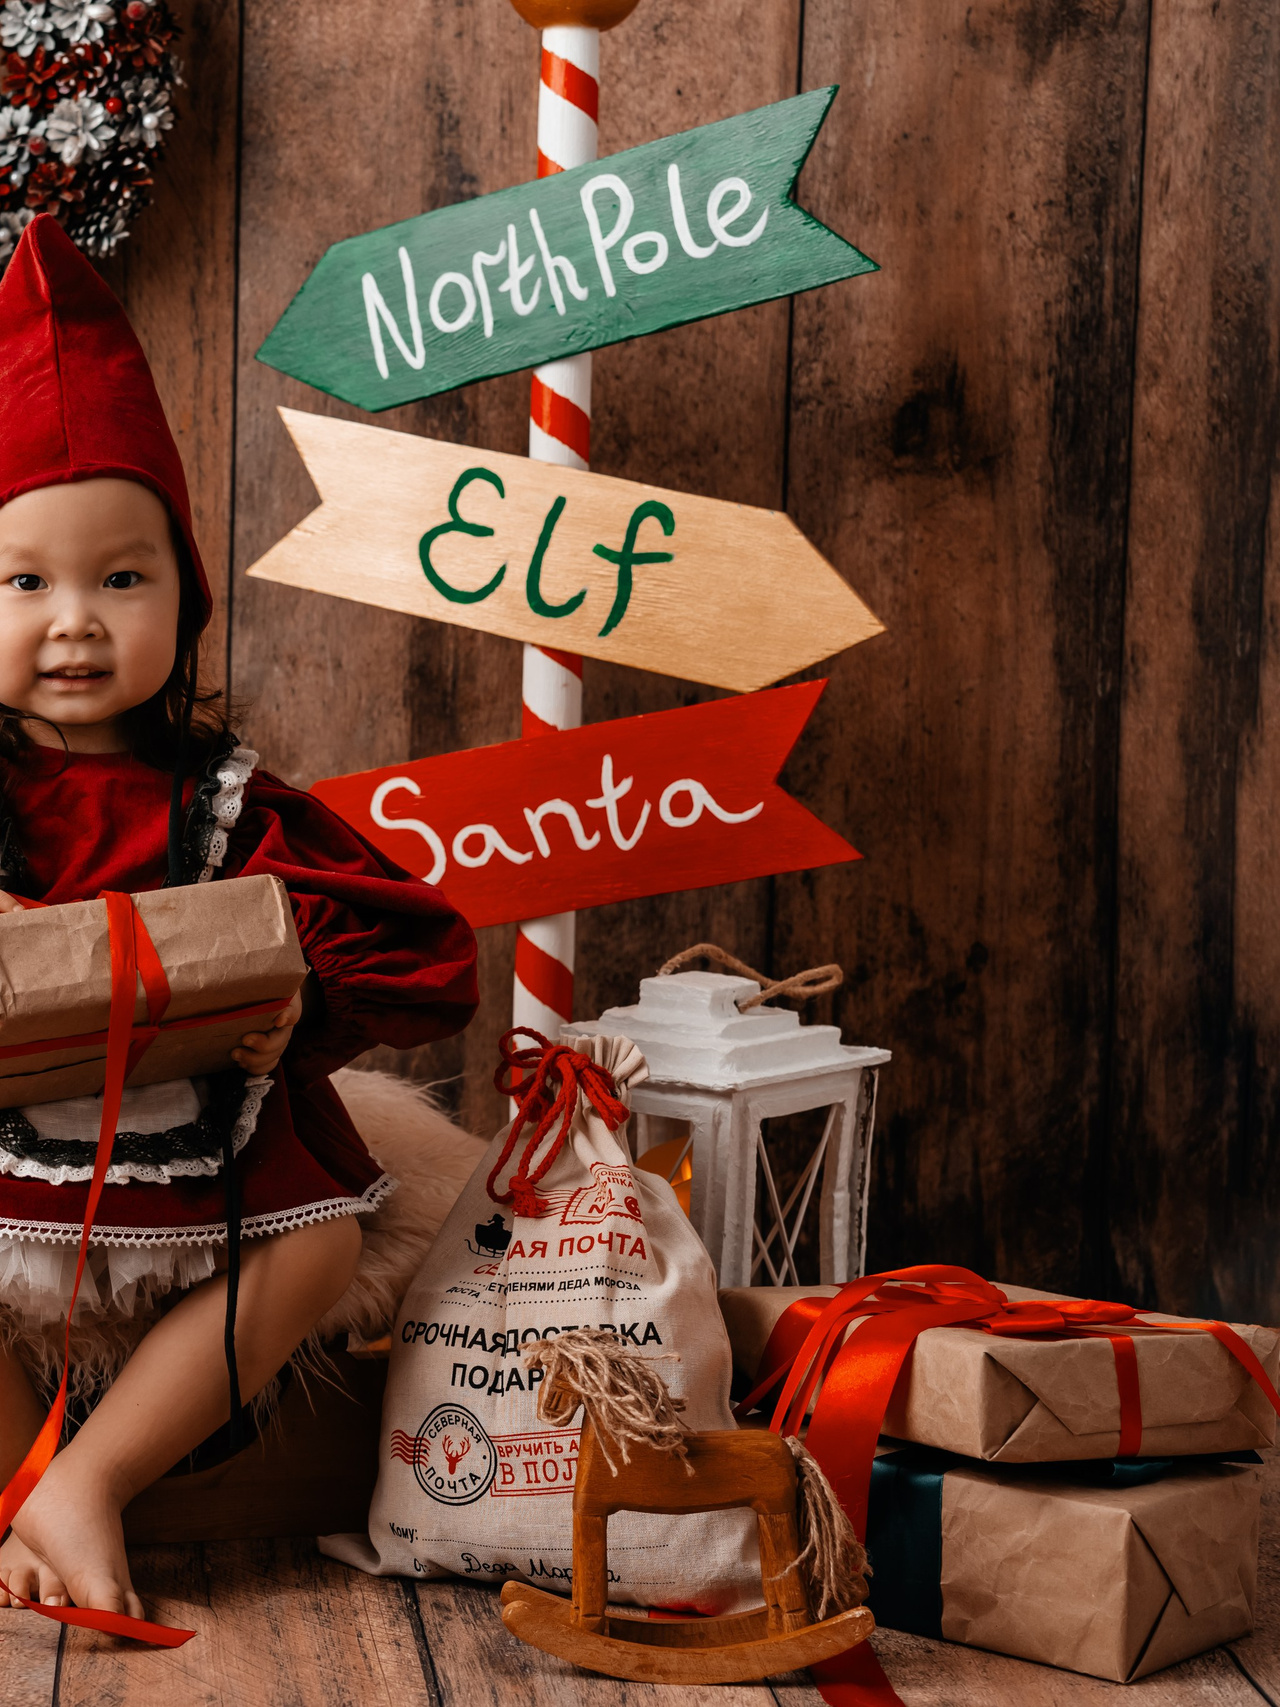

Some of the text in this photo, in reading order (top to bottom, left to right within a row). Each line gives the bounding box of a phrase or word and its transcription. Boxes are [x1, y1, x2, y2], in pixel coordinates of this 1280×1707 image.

[361, 163, 769, 380] North Pole
[418, 467, 676, 637] Elf
[370, 753, 764, 885] Santa
[558, 1231, 647, 1261] ПОЧТА
[558, 1278, 591, 1292] ДЕДА
[594, 1276, 642, 1292] МОРОЗА
[401, 1320, 663, 1359] СРОЧНАЯ ДОСТКА
[451, 1363, 545, 1398] ПОДАР
[428, 1414, 483, 1445] СЕВЕРНАЯ
[497, 1440, 580, 1458] ВРУЧИТЬ А
[424, 1466, 482, 1494] ПОЧТА
[500, 1457, 579, 1485] В ПОЛ
[389, 1522, 418, 1543] Кому:
[527, 1558, 621, 1584] Мора
